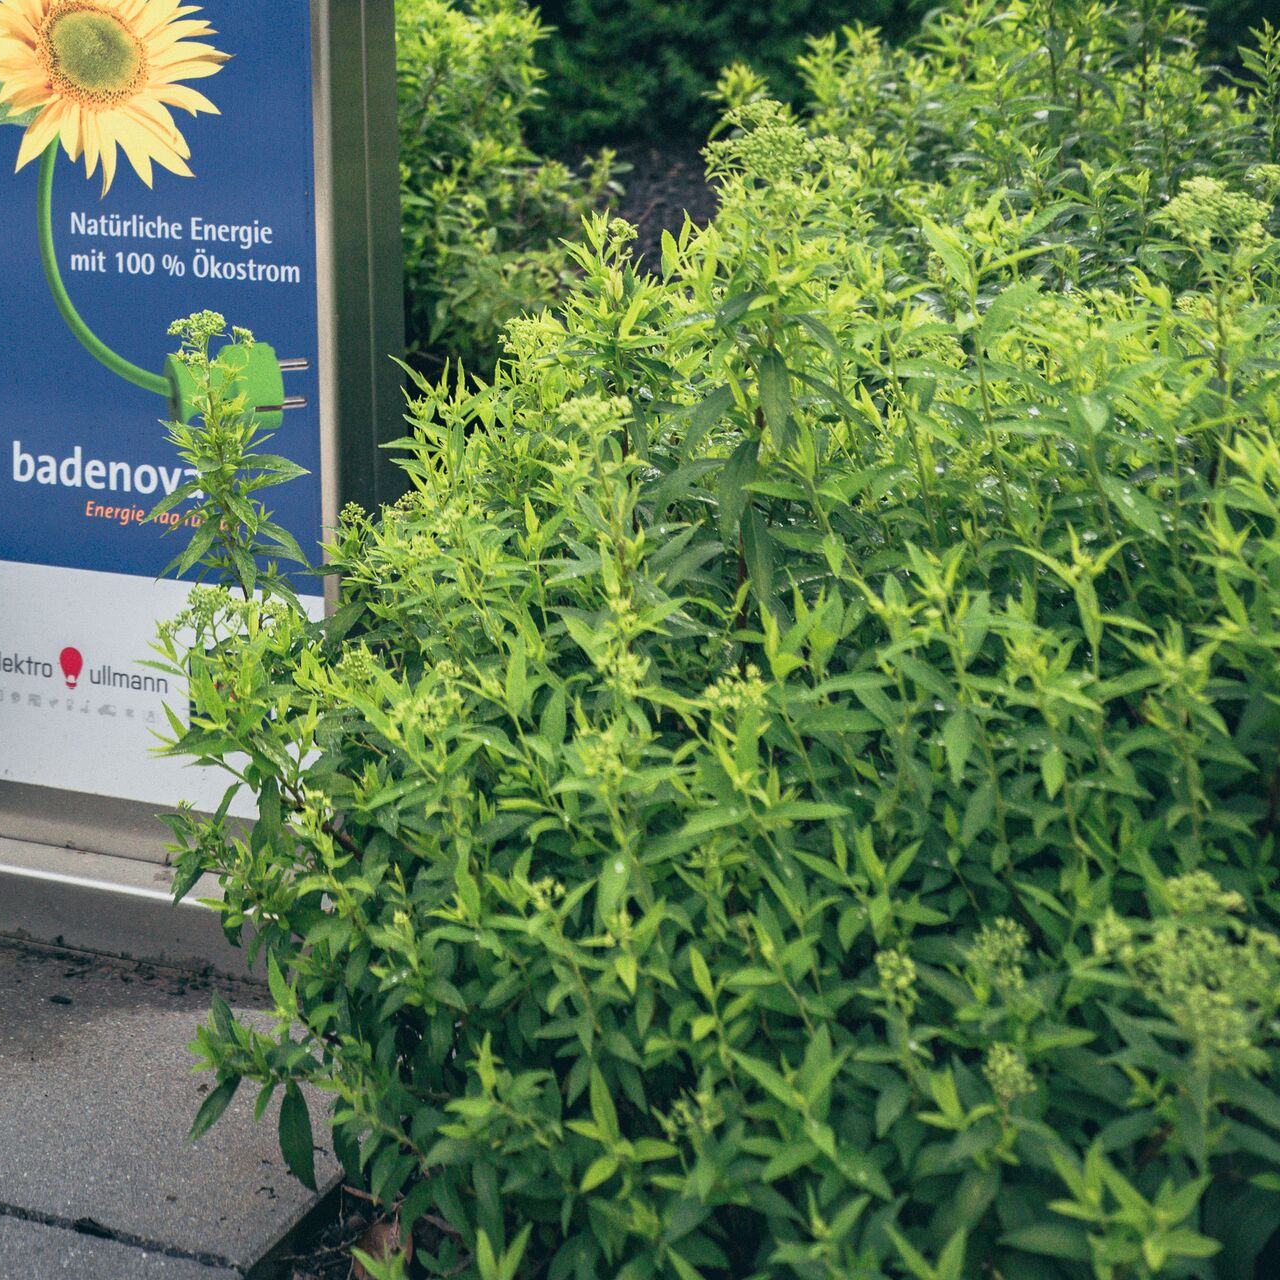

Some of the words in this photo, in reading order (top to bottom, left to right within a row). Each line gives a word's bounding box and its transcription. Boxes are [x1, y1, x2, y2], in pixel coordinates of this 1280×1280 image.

[70, 212, 183, 240] Natürliche
[191, 217, 273, 250] Energie
[70, 249, 106, 273] mit
[115, 251, 155, 276] 100
[162, 254, 185, 278] %
[193, 246, 301, 283] Ökostrom
[90, 664, 168, 694] ullmann
